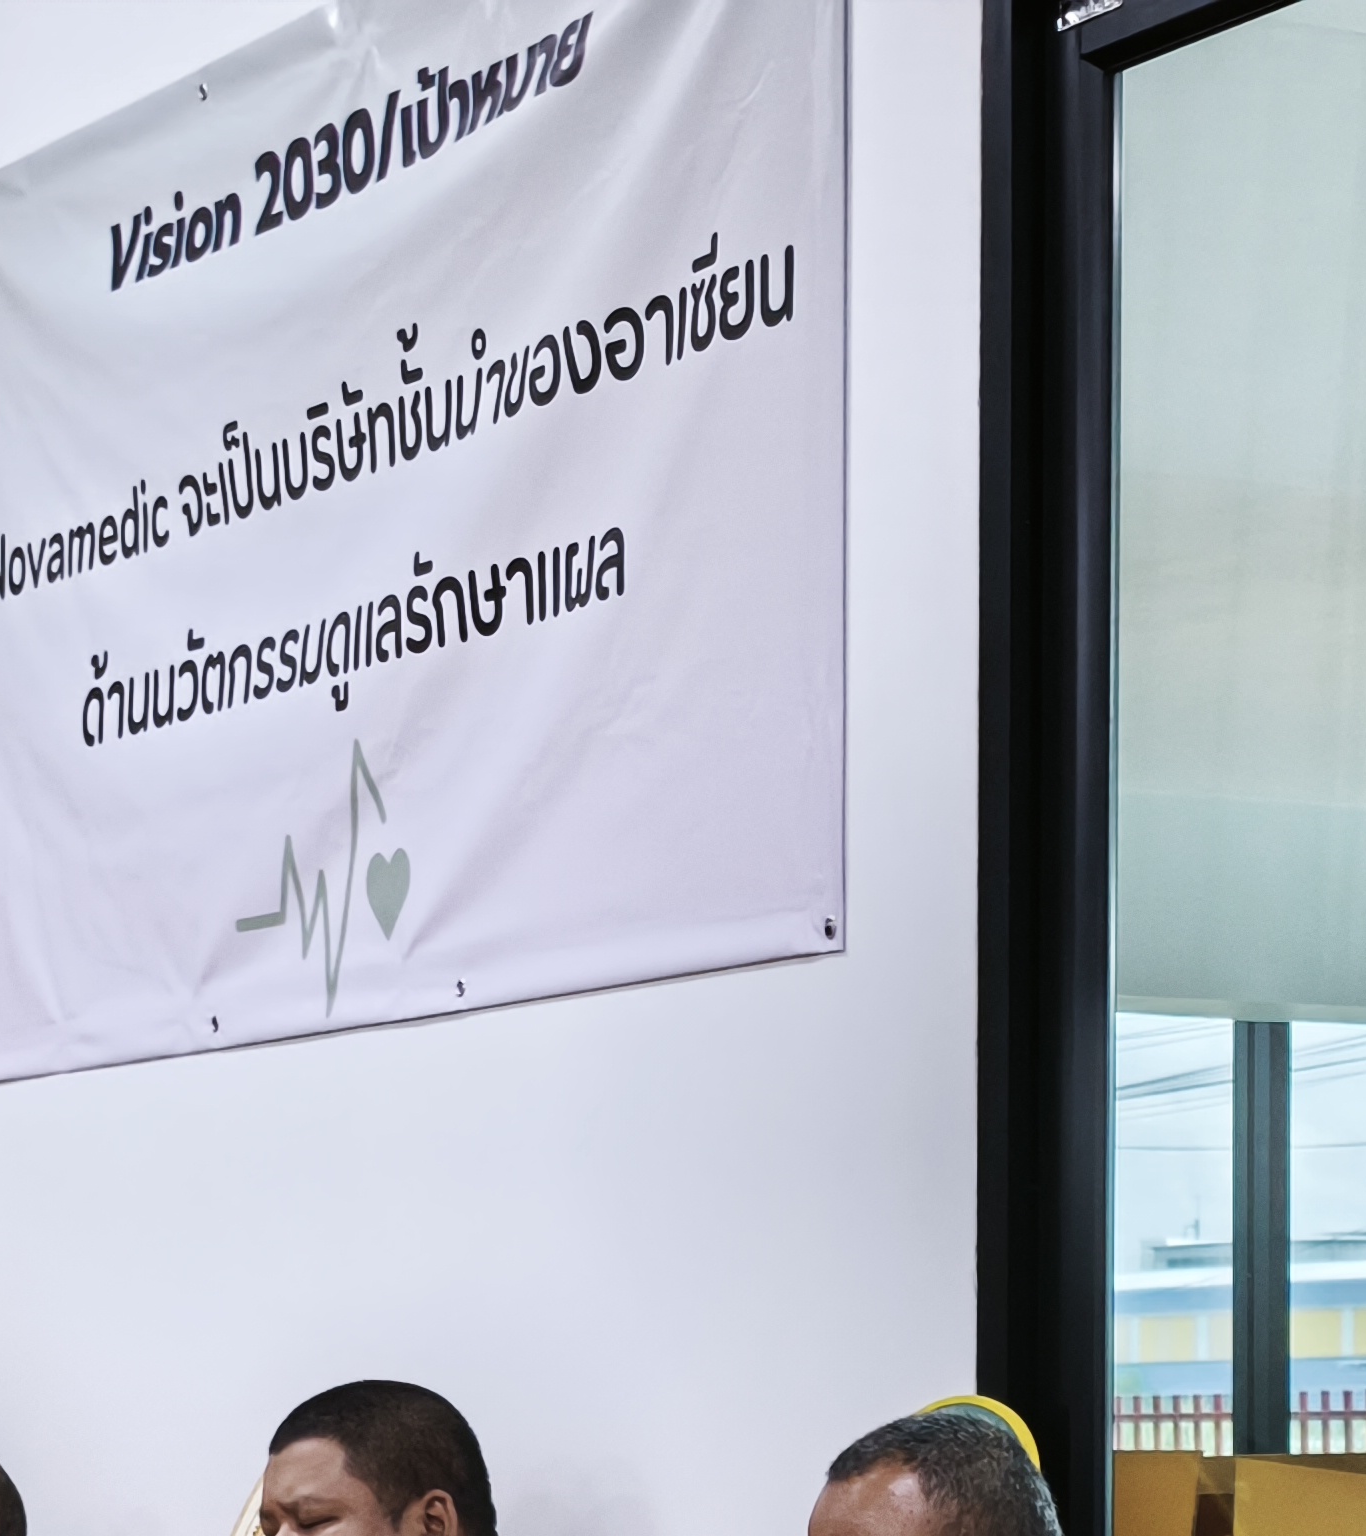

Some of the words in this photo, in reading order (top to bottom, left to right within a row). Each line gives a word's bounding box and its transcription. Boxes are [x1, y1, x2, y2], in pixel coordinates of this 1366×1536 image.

[110, 190, 243, 292] Vision
[255, 11, 595, 236] 2030/เป้าหมาย
[177, 231, 795, 539] จะเป็นบริษัทชั้นนำของอาเซียน
[81, 526, 625, 748] ด้านนวัตกรรมดูแลรักษาแผล
